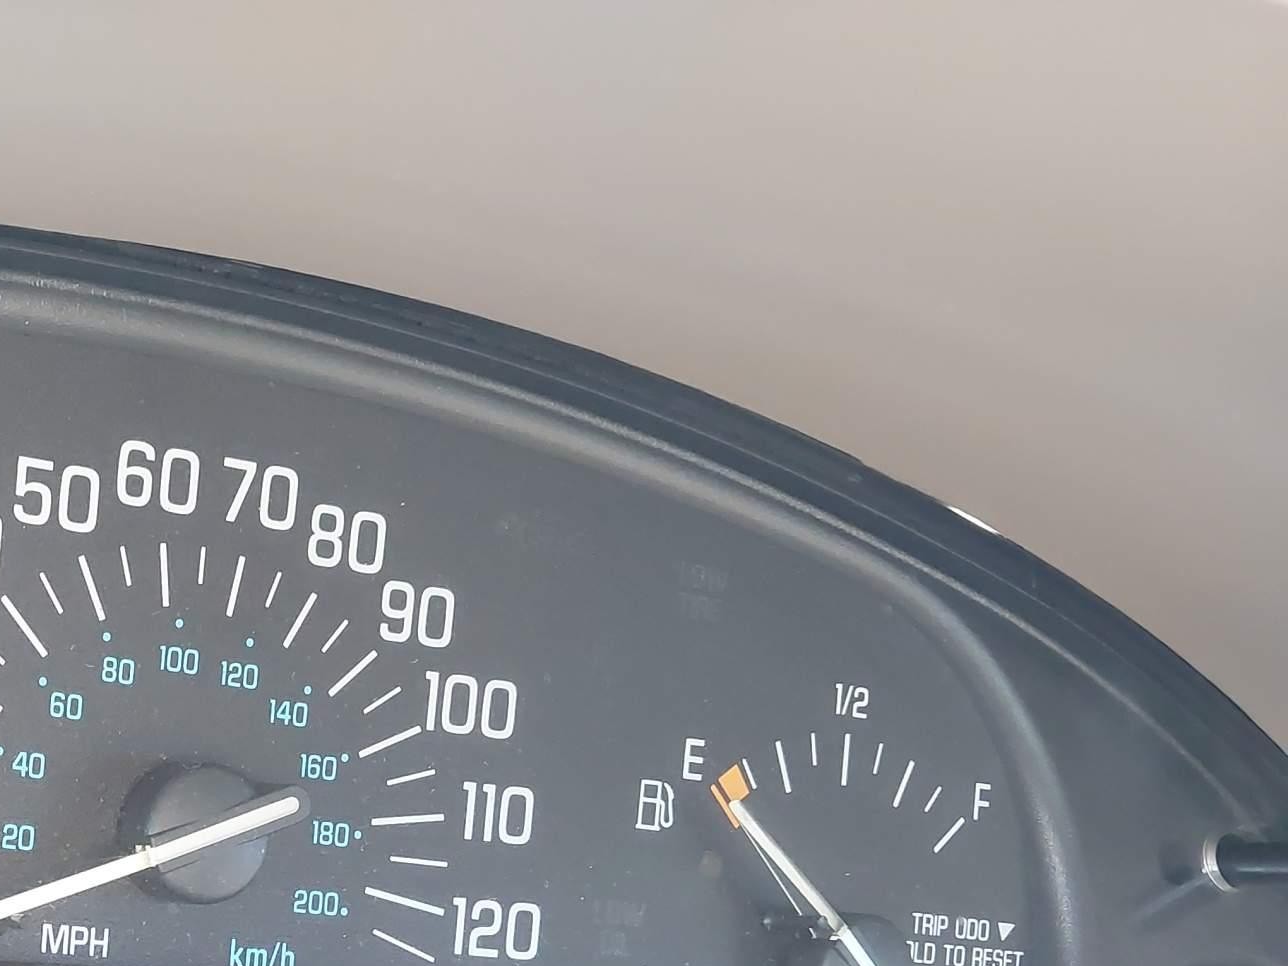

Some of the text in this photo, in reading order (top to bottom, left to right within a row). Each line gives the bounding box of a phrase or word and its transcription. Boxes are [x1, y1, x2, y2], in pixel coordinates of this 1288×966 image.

[117, 440, 199, 514] 60
[224, 457, 298, 530] 70
[14, 456, 99, 532] 50
[308, 504, 386, 573] 80
[379, 581, 454, 648] 90
[102, 657, 134, 684] 80
[160, 646, 198, 674] 100
[222, 661, 258, 689] 120
[50, 692, 82, 719] 60
[271, 699, 307, 726] 140
[426, 671, 517, 739] 100
[836, 684, 869, 718] 1/2
[13, 752, 45, 778] 40
[301, 754, 336, 780] 160
[683, 739, 705, 780] E
[463, 782, 534, 844] 110
[973, 783, 991, 820] F
[2, 824, 34, 850] 20
[313, 821, 349, 847] 180
[294, 890, 336, 915] 200
[42, 924, 109, 957] MPH
[453, 897, 540, 960] 120
[912, 913, 990, 941] TRIP ODO
